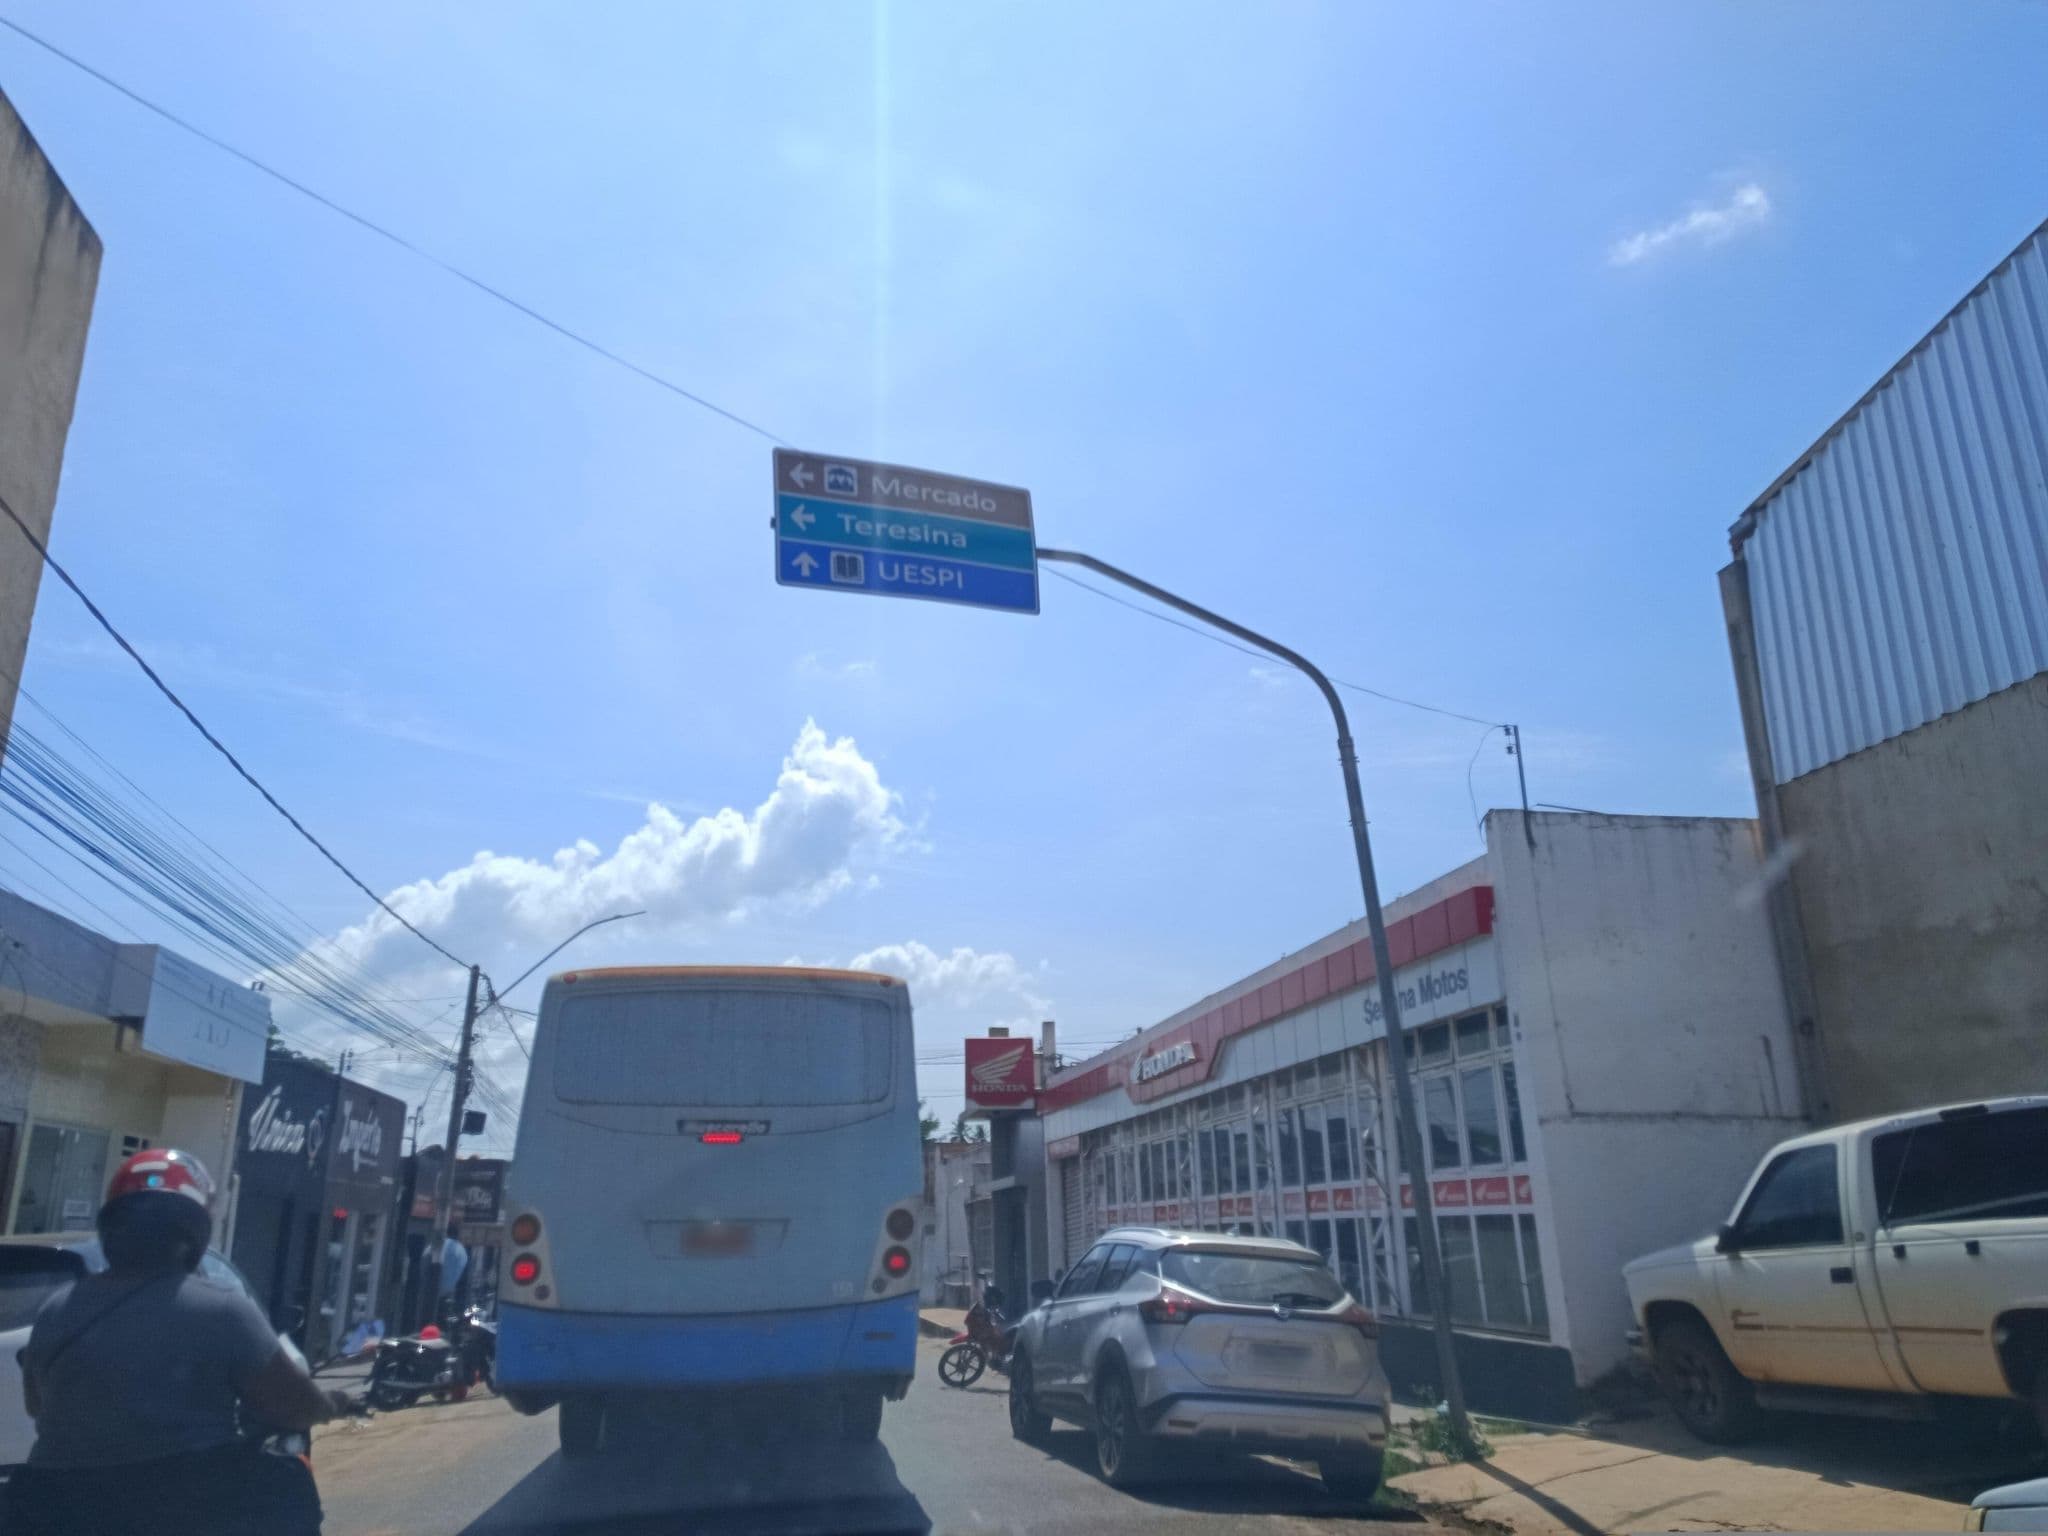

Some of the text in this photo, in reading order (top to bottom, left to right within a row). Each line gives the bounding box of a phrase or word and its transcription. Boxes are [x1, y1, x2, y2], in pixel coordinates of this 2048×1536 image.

[871, 475, 996, 513] Mercado
[837, 512, 967, 548] Teresina
[879, 561, 963, 589] UESPI
[1418, 968, 1469, 1005] Motos
[972, 1083, 1028, 1093] HONDA
